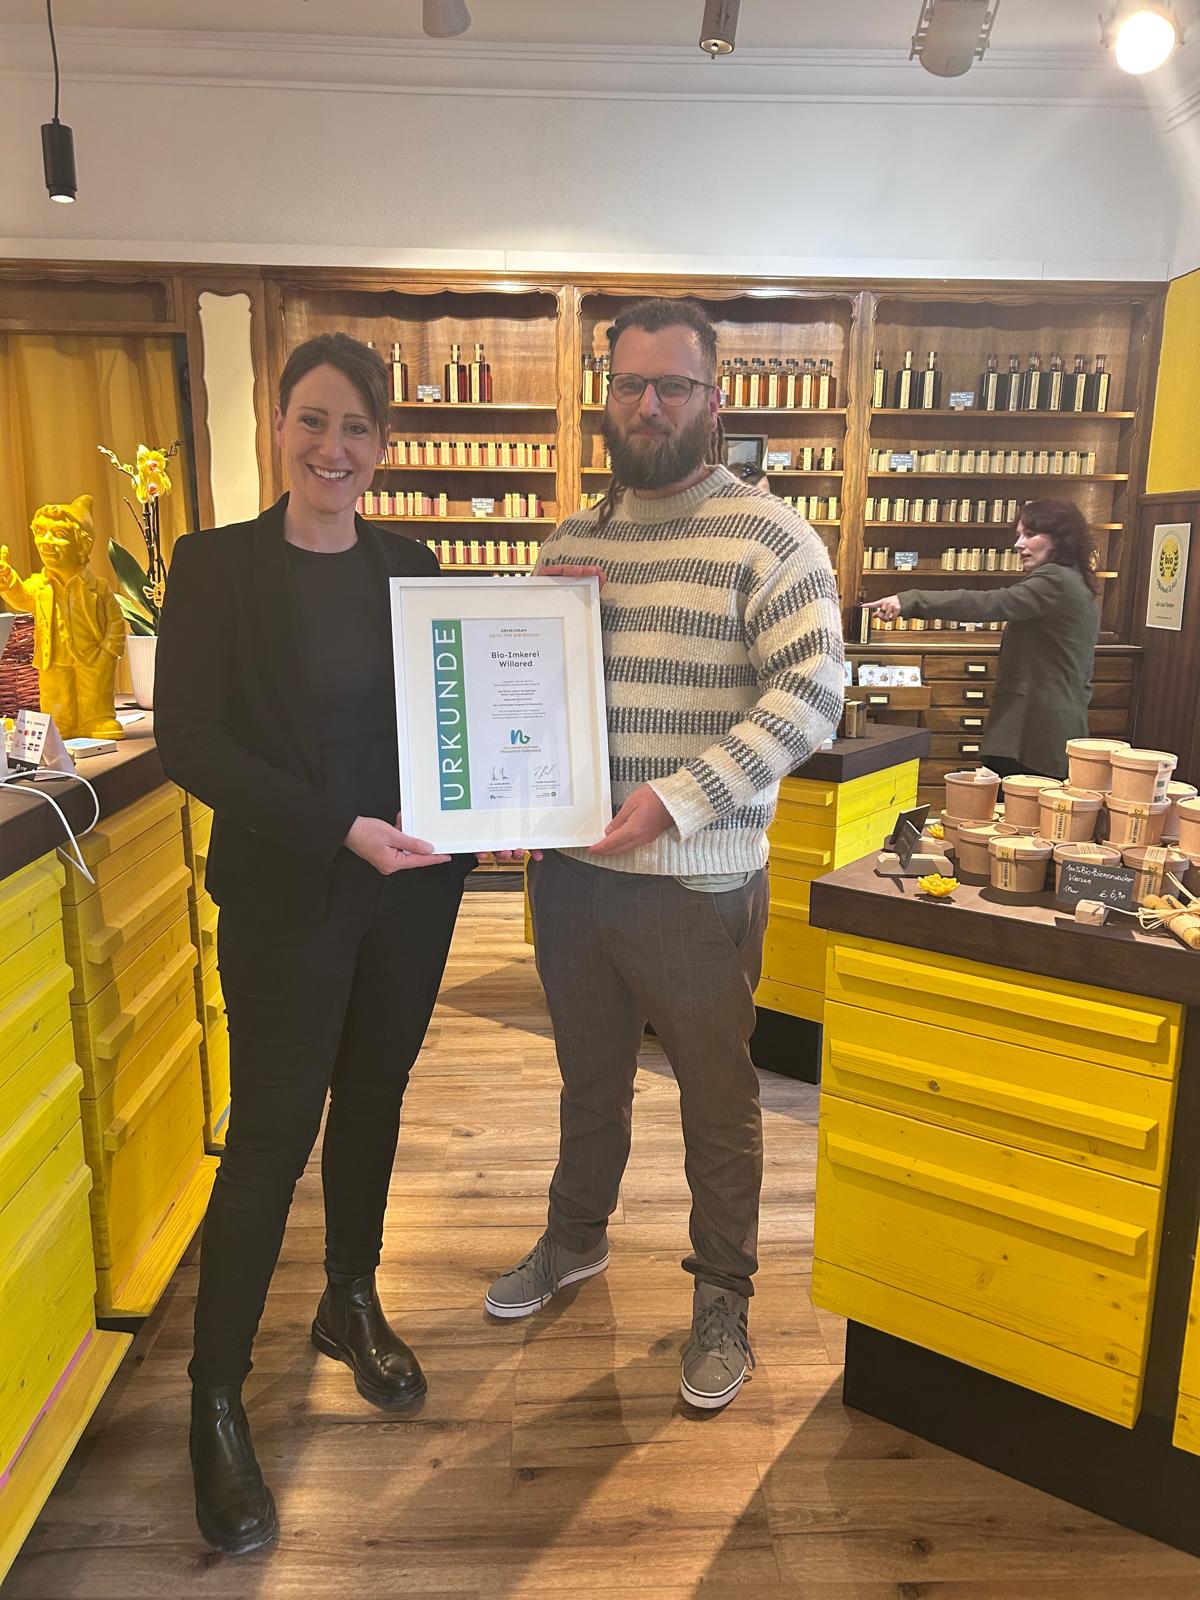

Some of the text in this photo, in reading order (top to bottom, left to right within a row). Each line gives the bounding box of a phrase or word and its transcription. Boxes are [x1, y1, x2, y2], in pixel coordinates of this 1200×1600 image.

[491, 651, 540, 659] Bio-Imkerei
[435, 628, 464, 801] URKUNDE
[1068, 873, 1092, 885] Kerzen
